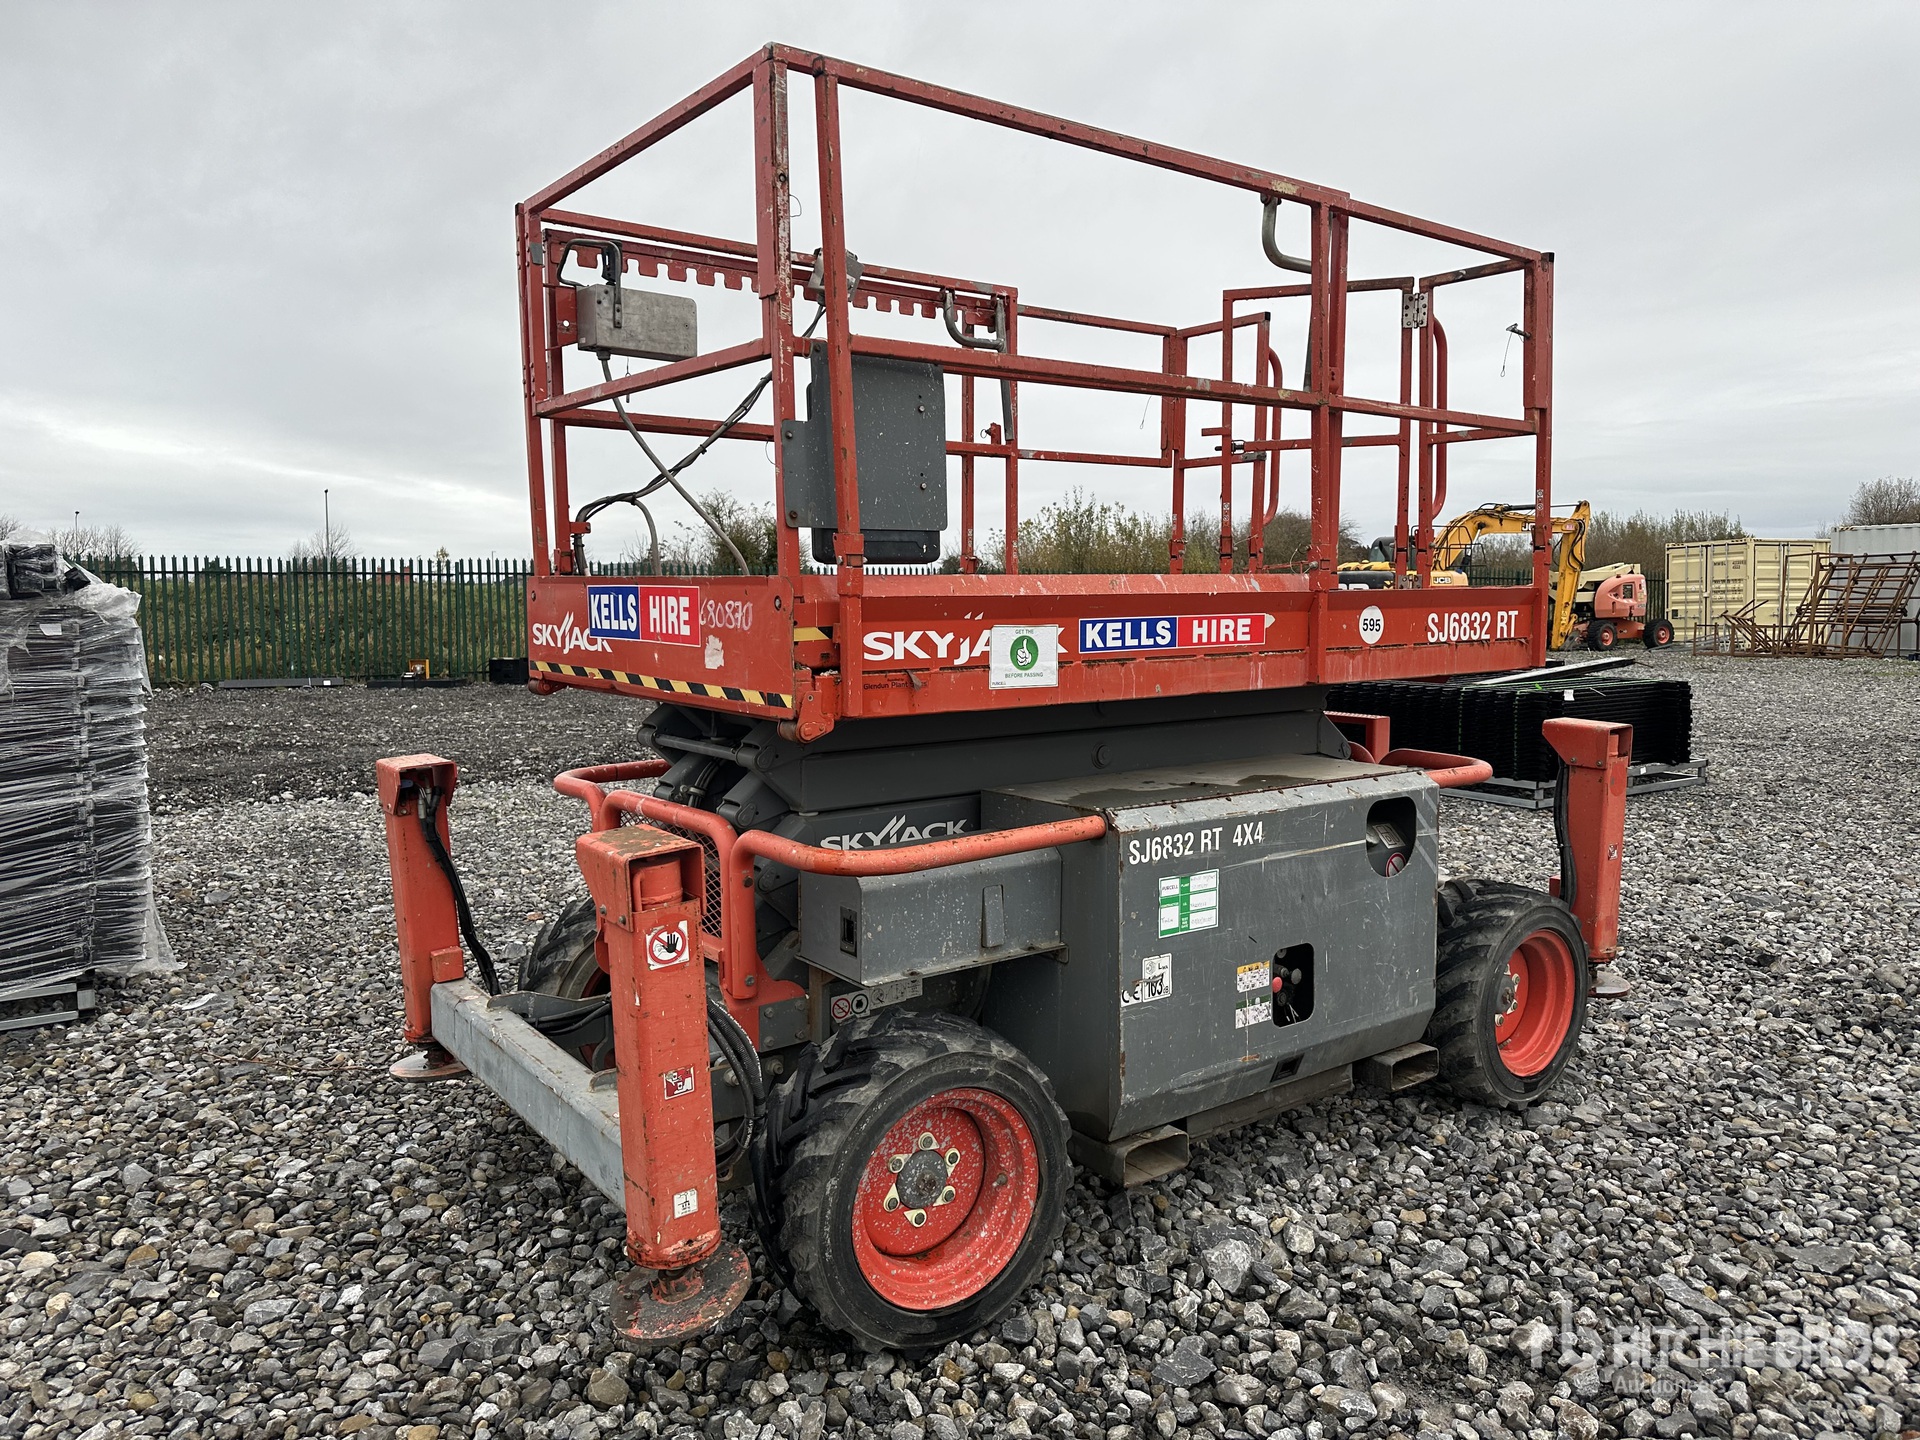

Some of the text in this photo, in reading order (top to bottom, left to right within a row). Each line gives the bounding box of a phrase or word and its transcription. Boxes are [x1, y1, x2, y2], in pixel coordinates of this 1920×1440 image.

[590, 593, 691, 636] KELLS HIRE
[700, 597, 754, 631] 680870
[1362, 618, 1381, 632] 595
[1427, 610, 1519, 643] SJ6832 RT
[1085, 618, 1252, 649] KELLS HIRE
[820, 814, 968, 851] SKYJACK
[1128, 820, 1263, 865] SJ6832 RT 4X4
